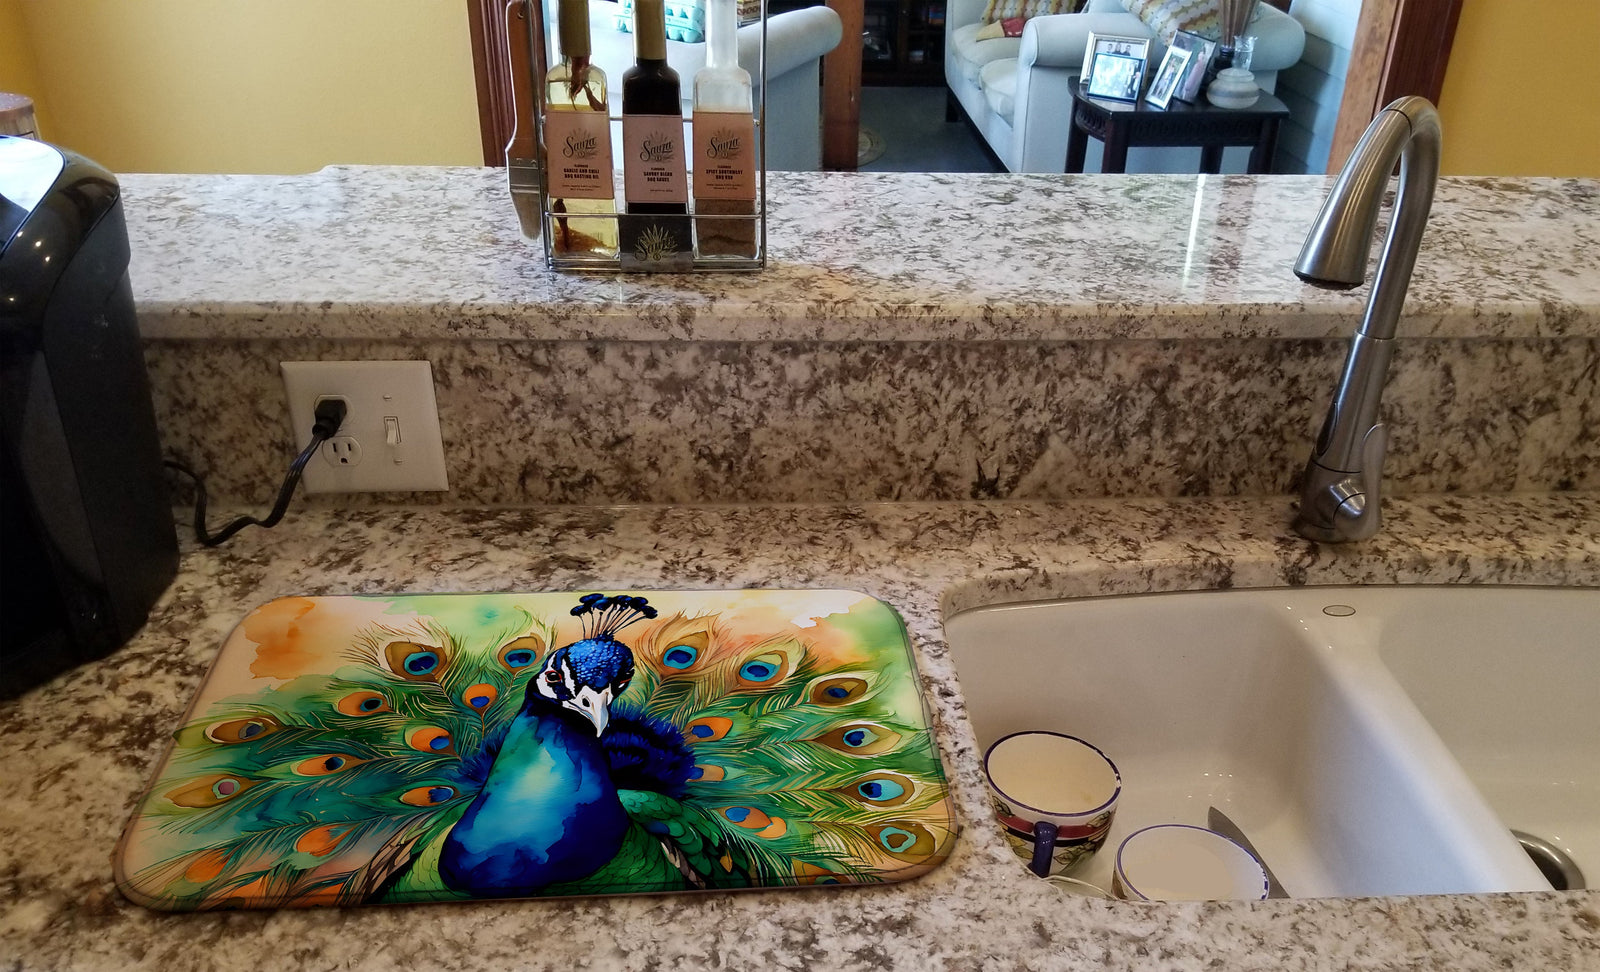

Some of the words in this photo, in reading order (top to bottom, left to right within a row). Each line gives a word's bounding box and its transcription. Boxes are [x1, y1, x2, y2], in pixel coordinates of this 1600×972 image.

[562, 136, 597, 158] Sauza
[640, 140, 673, 161] Sauza
[707, 136, 740, 158] Sauza
